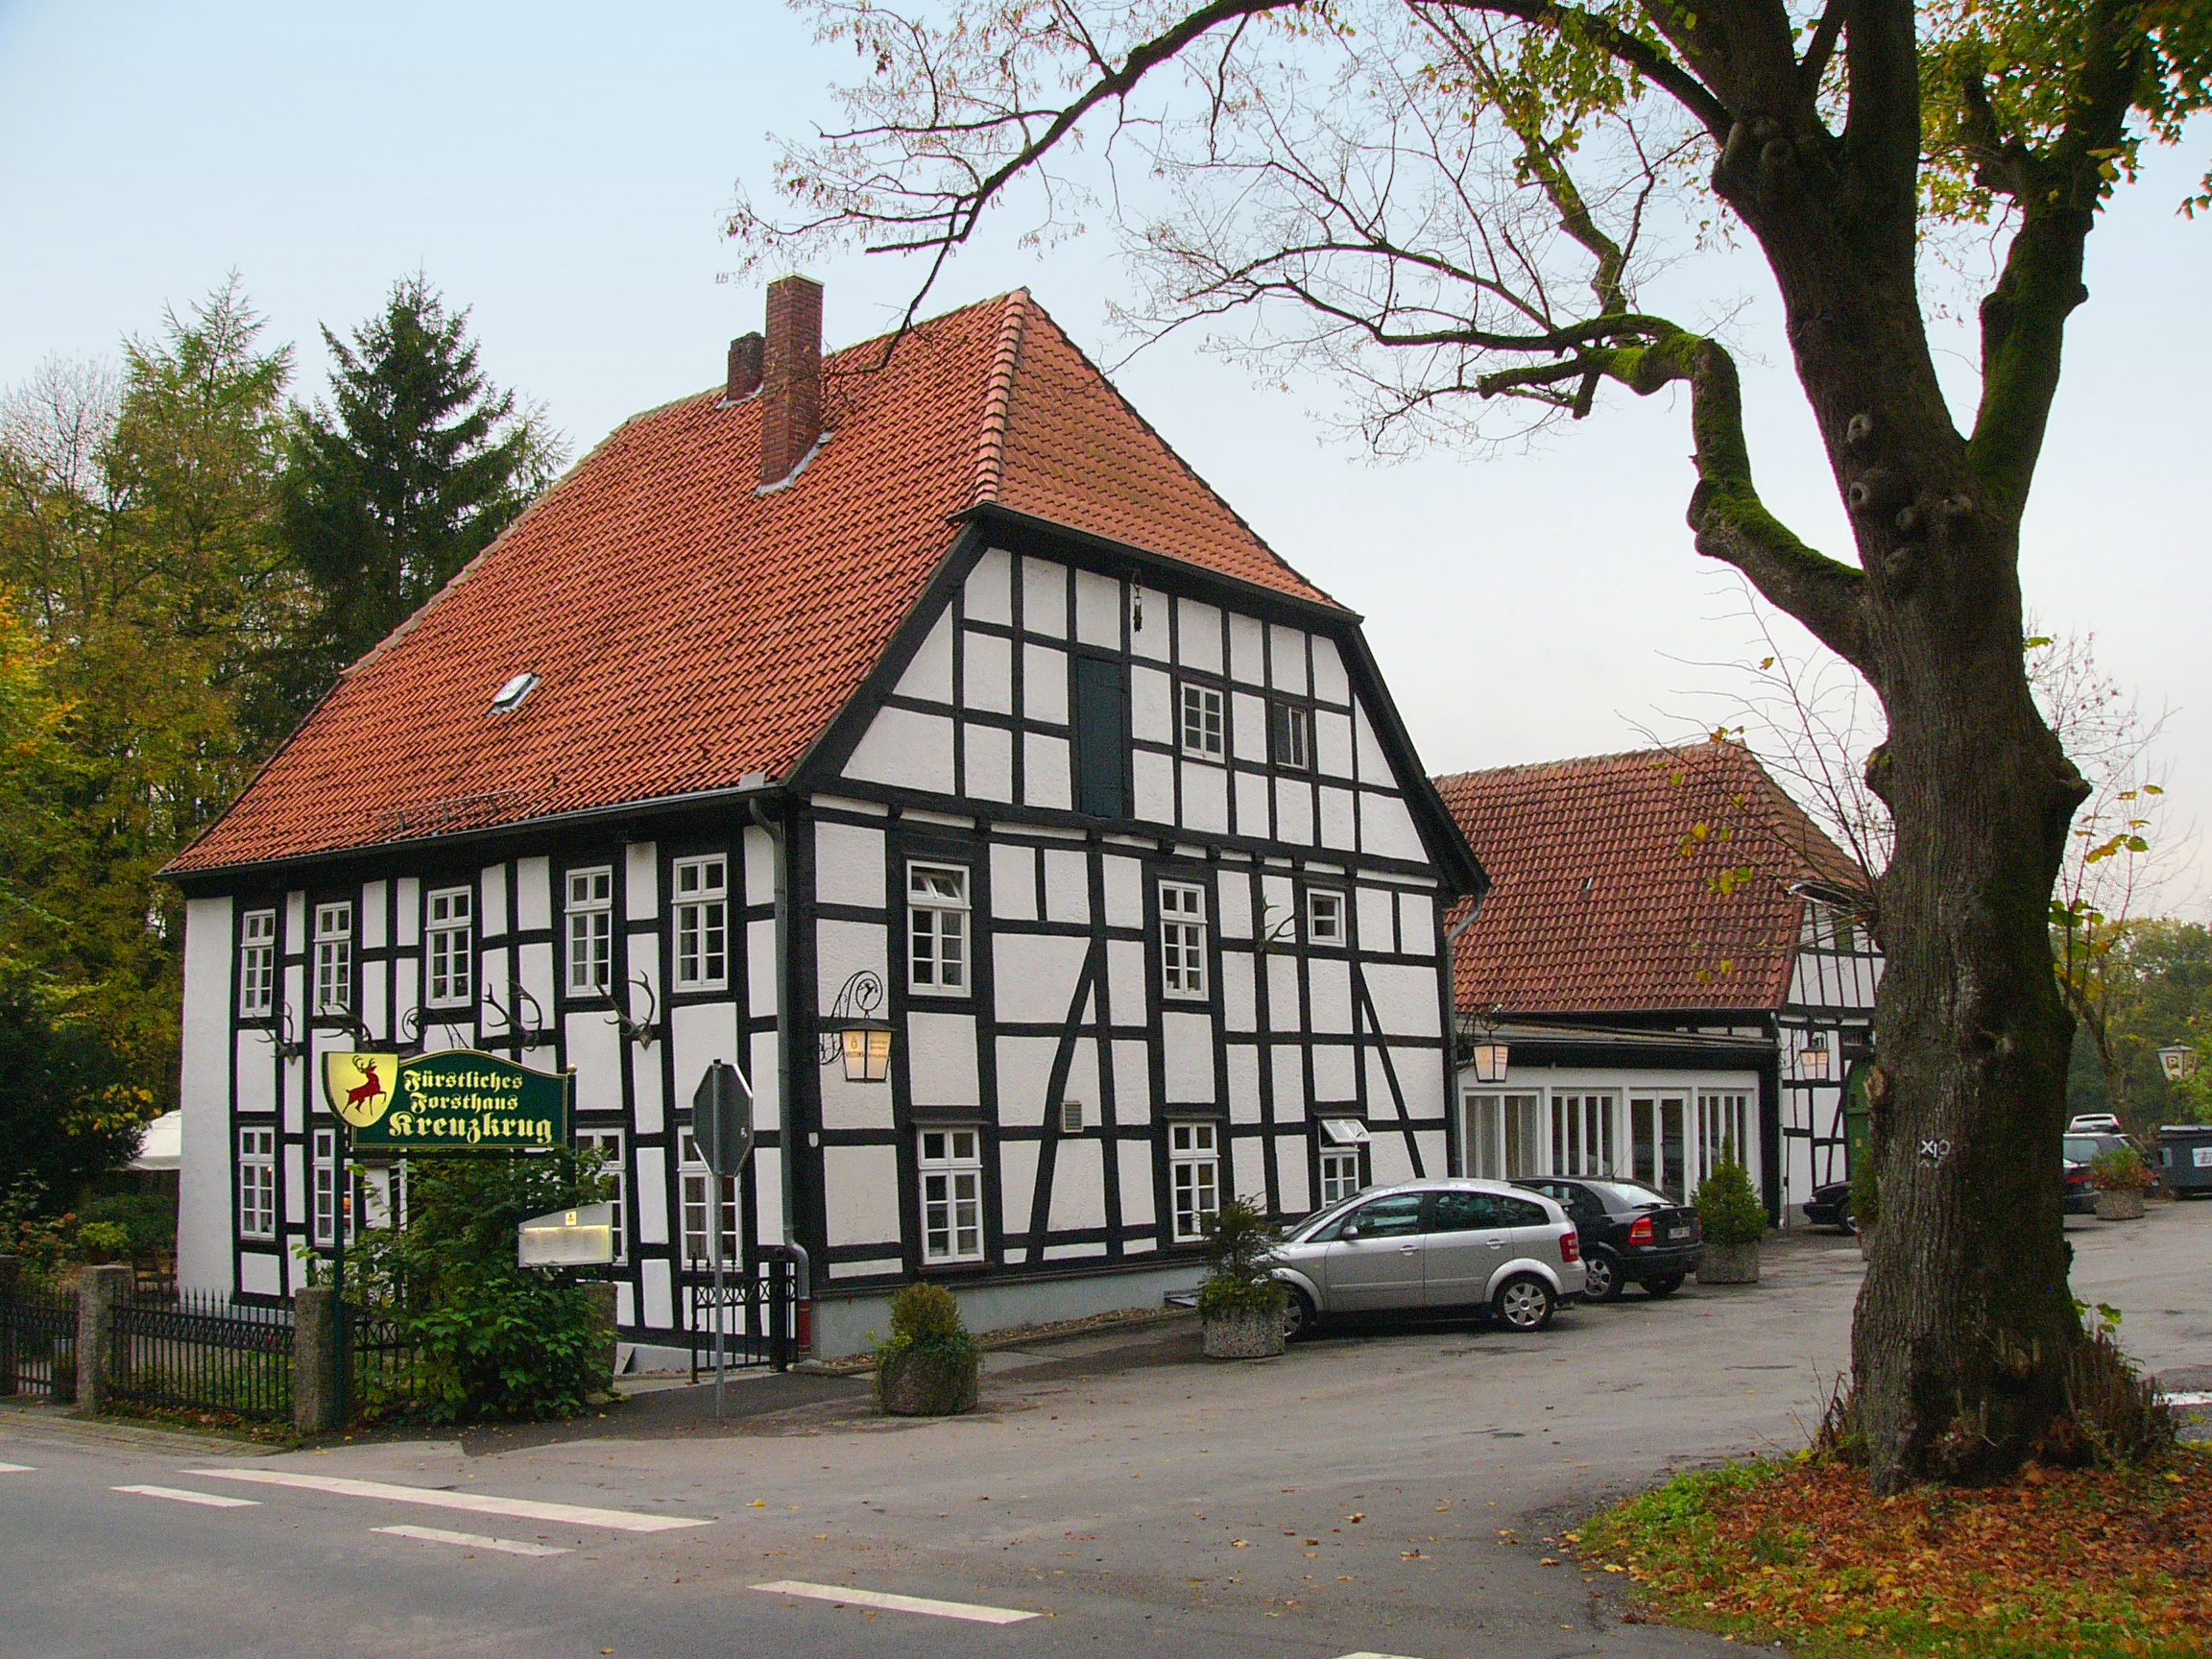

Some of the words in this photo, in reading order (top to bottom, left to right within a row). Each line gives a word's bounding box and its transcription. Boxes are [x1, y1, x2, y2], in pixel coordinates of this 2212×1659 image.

[403, 1070, 523, 1093] Fürstliches
[410, 1093, 518, 1114] Forsthaus
[389, 1111, 552, 1144] Kreuzkrug
